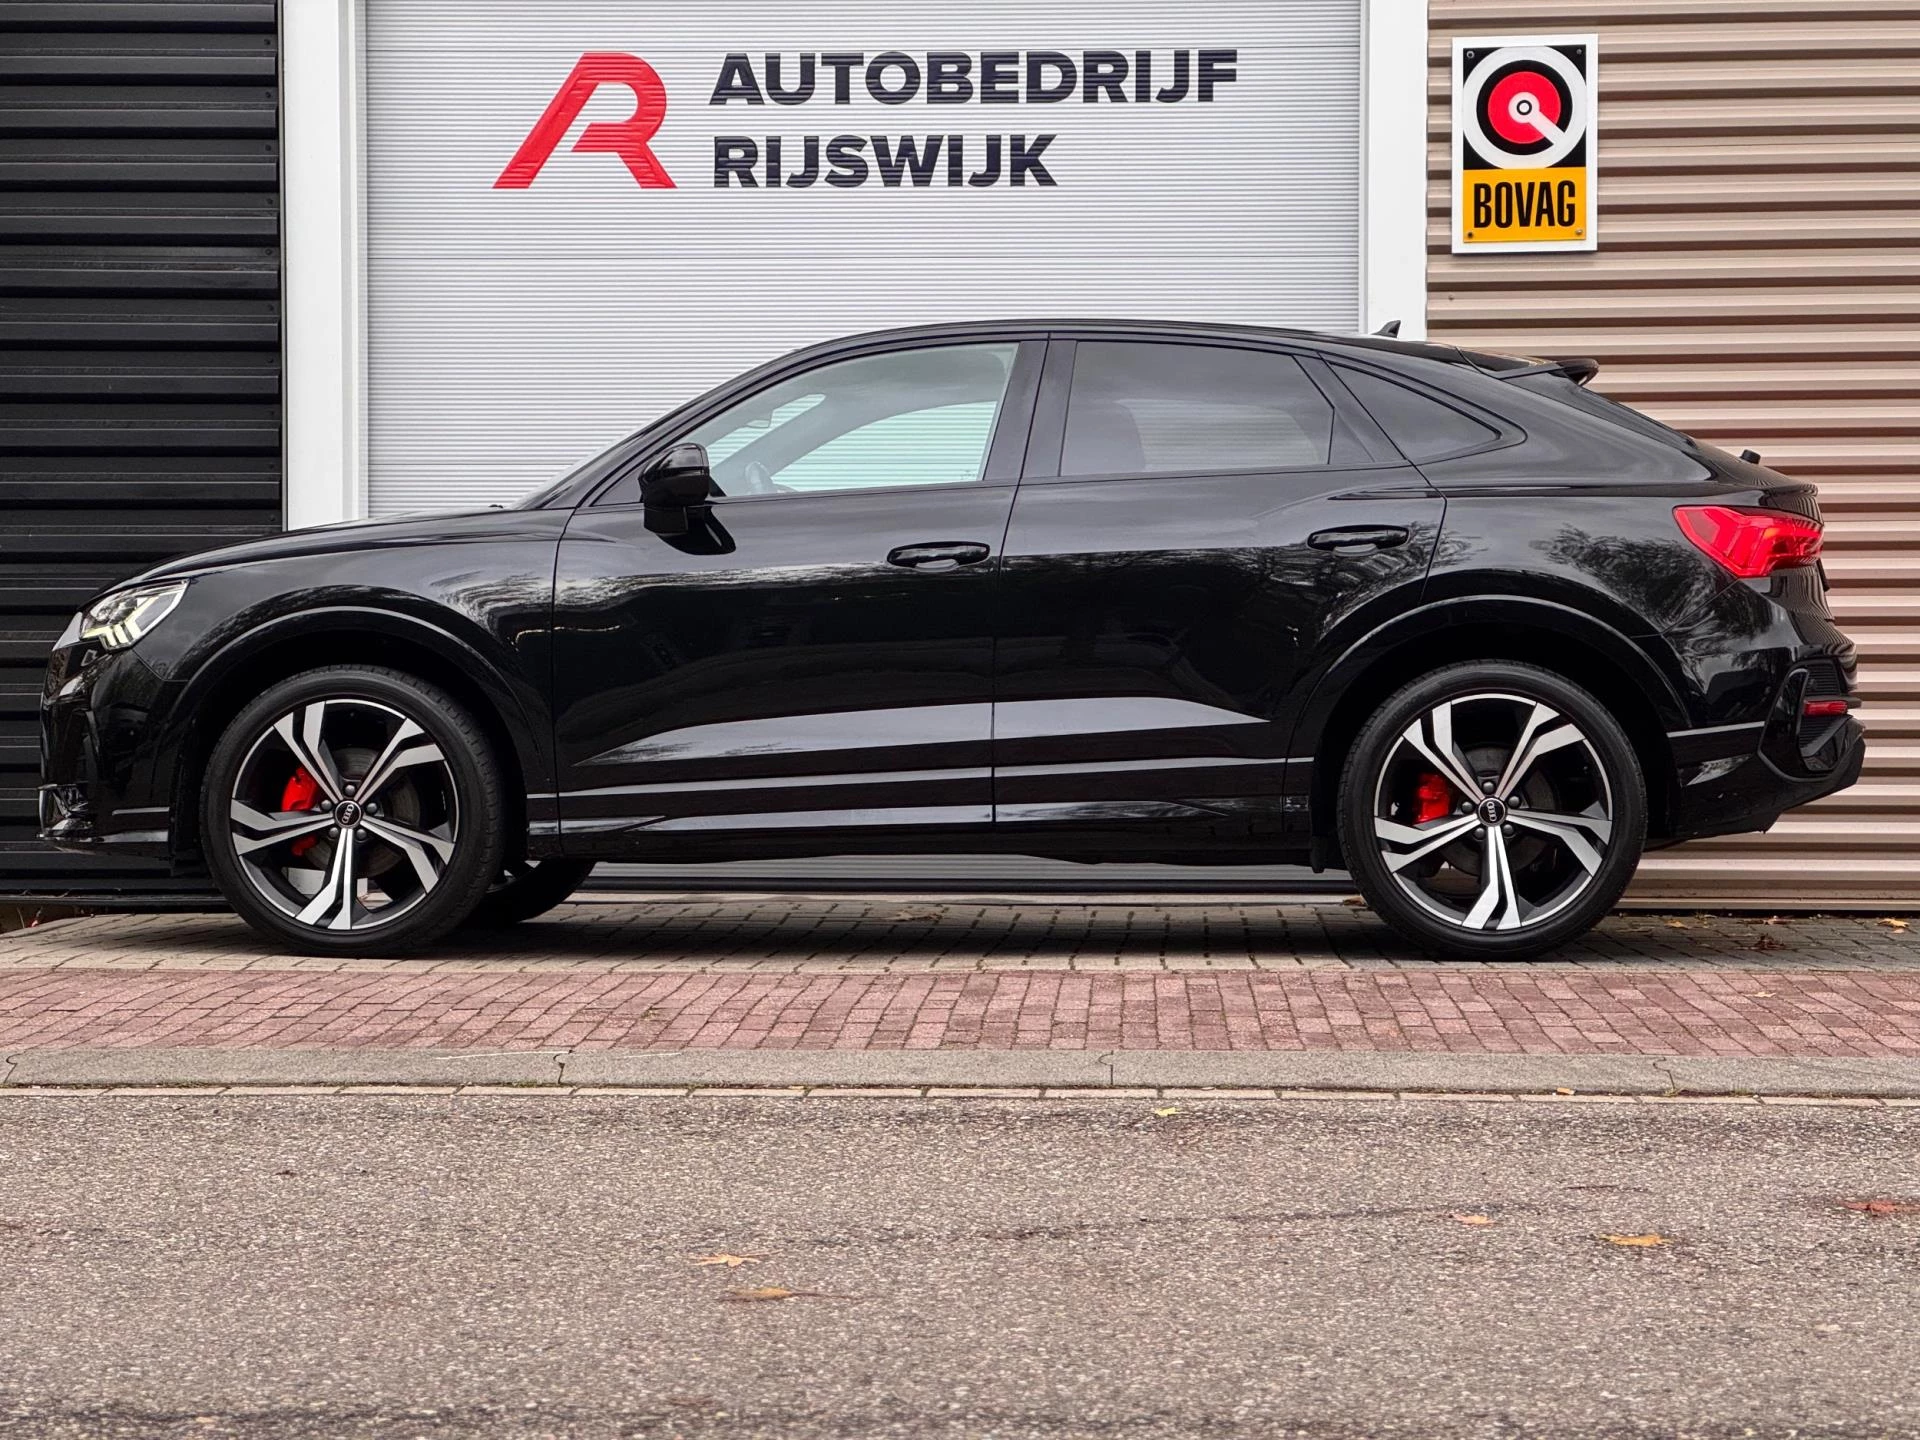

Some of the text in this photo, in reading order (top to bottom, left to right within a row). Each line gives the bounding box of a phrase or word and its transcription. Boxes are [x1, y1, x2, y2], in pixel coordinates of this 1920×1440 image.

[709, 49, 1238, 106] AUTOBEDRIJF
[713, 134, 1058, 188] RIJSWIJK
[1473, 180, 1576, 229] BOVAG
